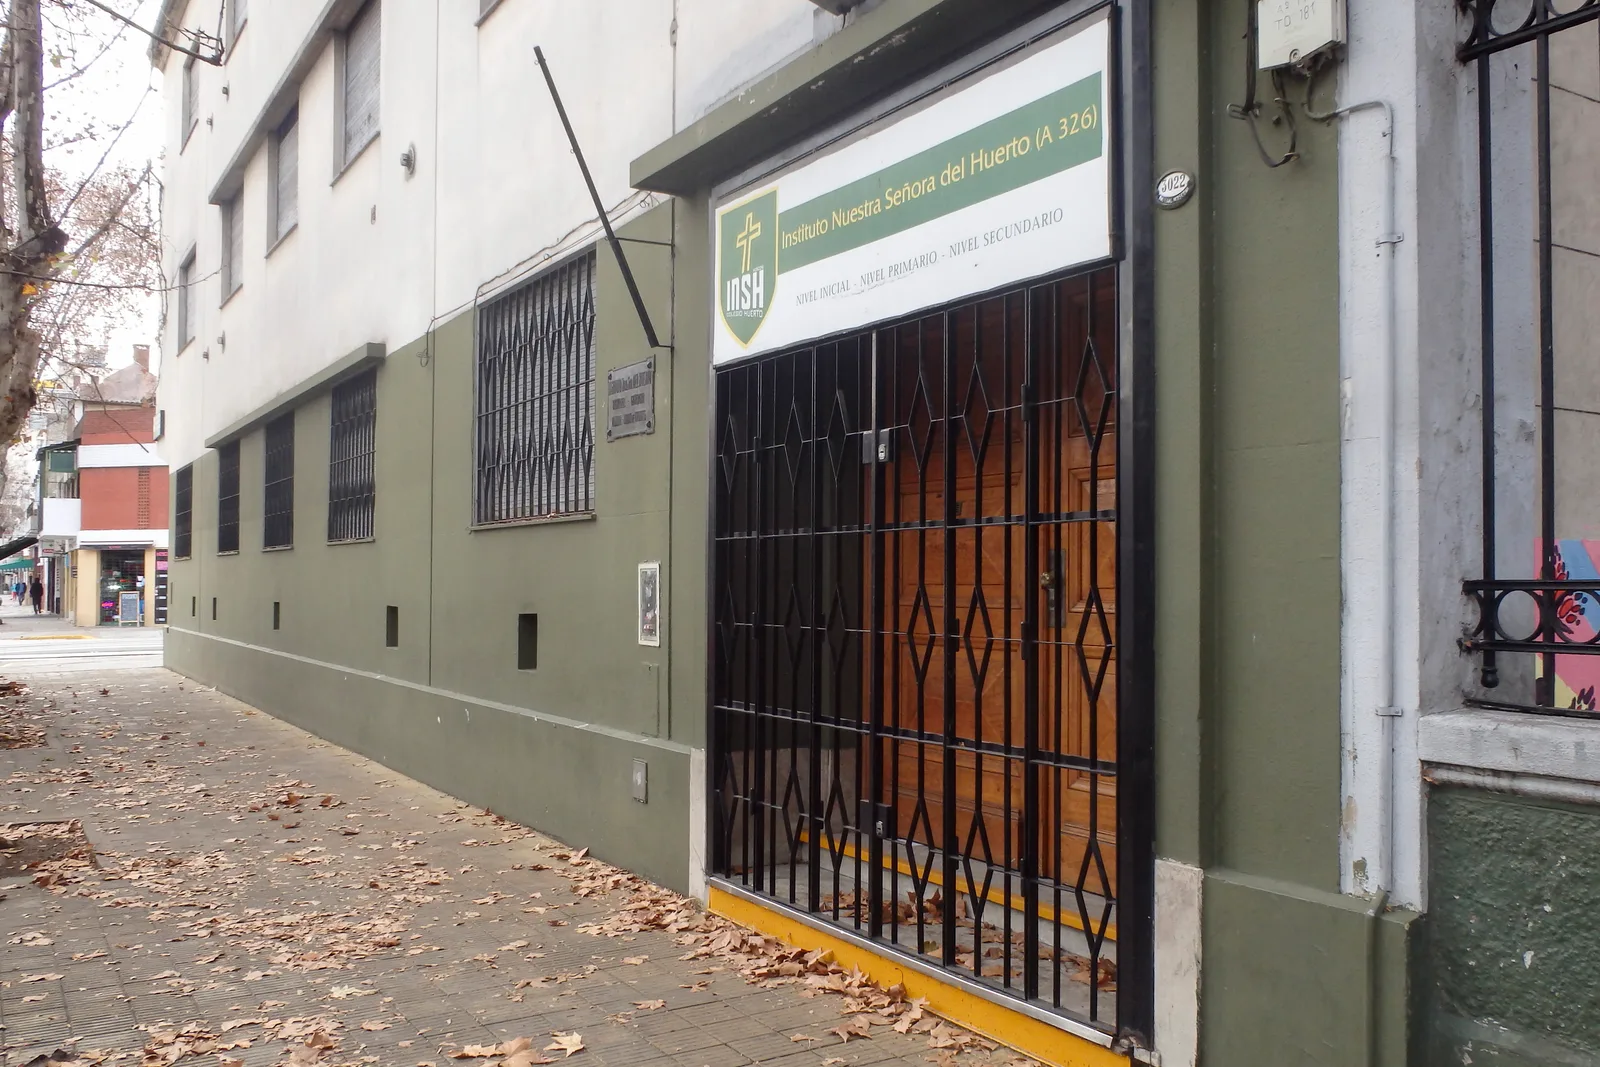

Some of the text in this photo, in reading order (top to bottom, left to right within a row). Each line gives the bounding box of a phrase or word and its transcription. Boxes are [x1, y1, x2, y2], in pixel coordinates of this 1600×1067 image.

[782, 104, 1098, 250] Instituto Nuestra Señora del Huerto (A 326)
[1161, 173, 1186, 193] 3022
[796, 289, 818, 306] NIVEL
[820, 279, 851, 299] INICIAL
[860, 268, 886, 287] NIVEL
[888, 250, 938, 278] PRIMARIO
[949, 236, 980, 258] NIVEL
[983, 207, 1063, 247] SECUNDARIO
[743, 309, 764, 318] HUERTO
